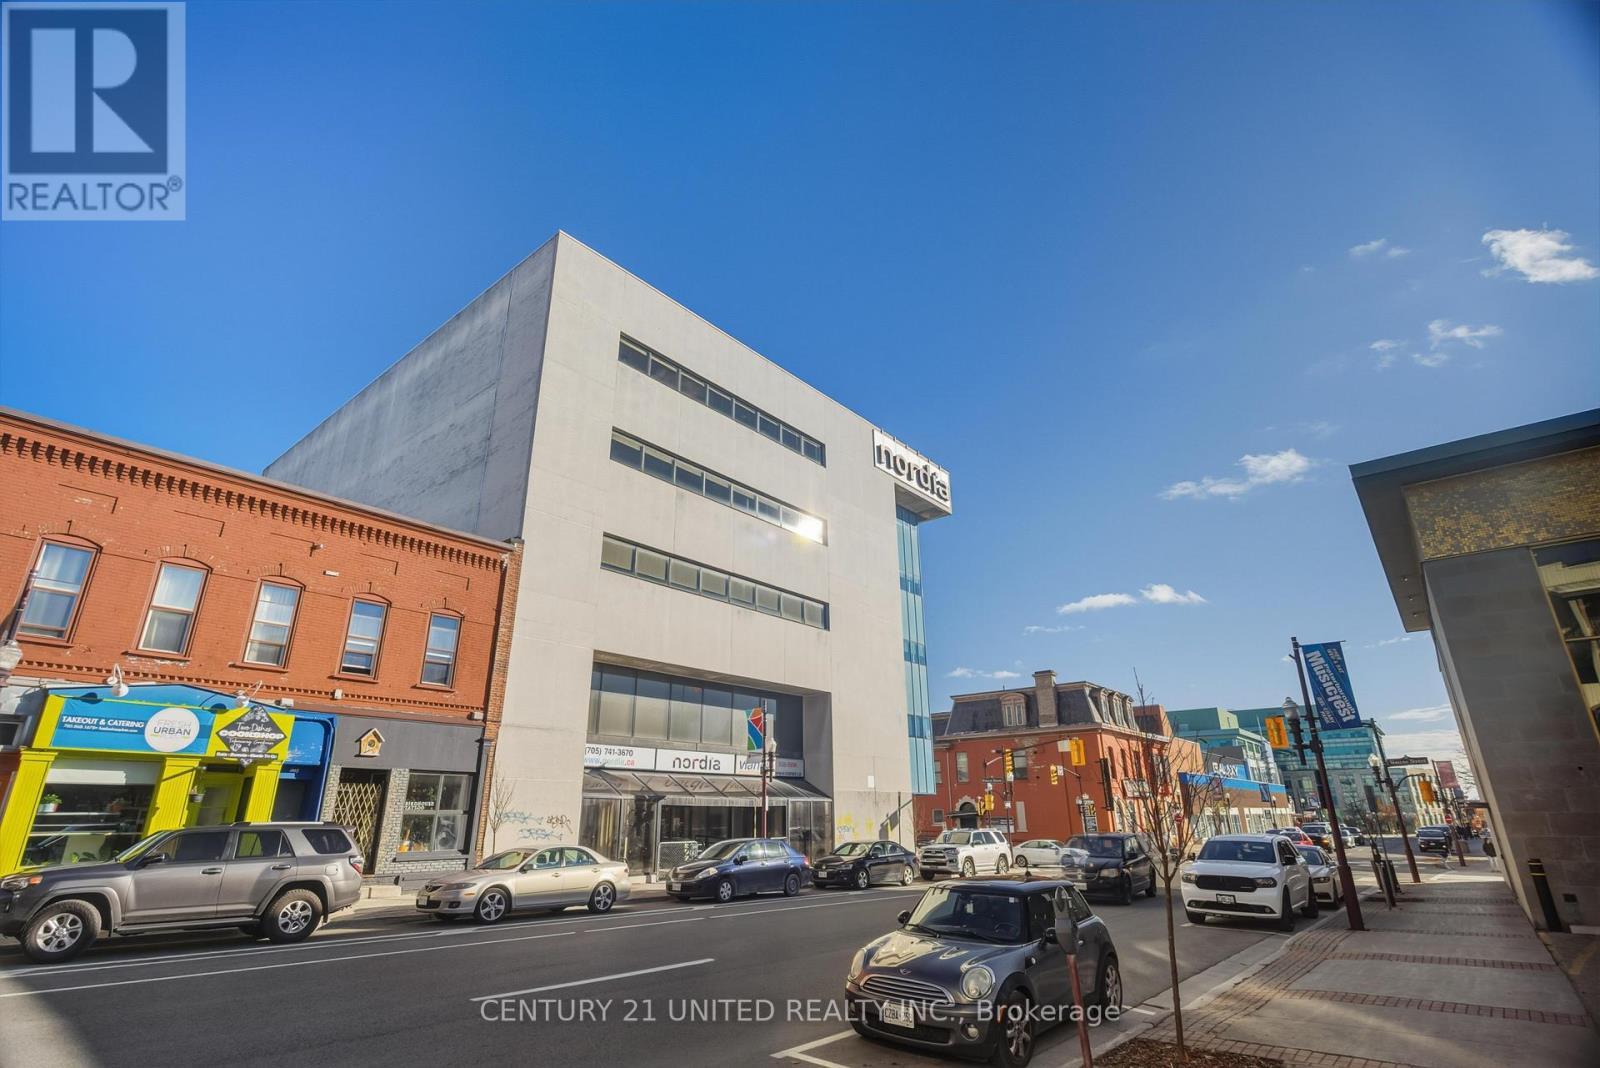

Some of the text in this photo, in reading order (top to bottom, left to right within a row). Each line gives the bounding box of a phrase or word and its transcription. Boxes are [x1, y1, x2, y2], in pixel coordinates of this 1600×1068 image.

[876, 444, 949, 502] nordia
[1305, 650, 1356, 722] Musicfest
[62, 715, 145, 728] TAKEOUT & CATERING
[153, 726, 191, 736] URBAN
[584, 746, 634, 757] (705) 741-3670
[672, 754, 721, 771] nordia
